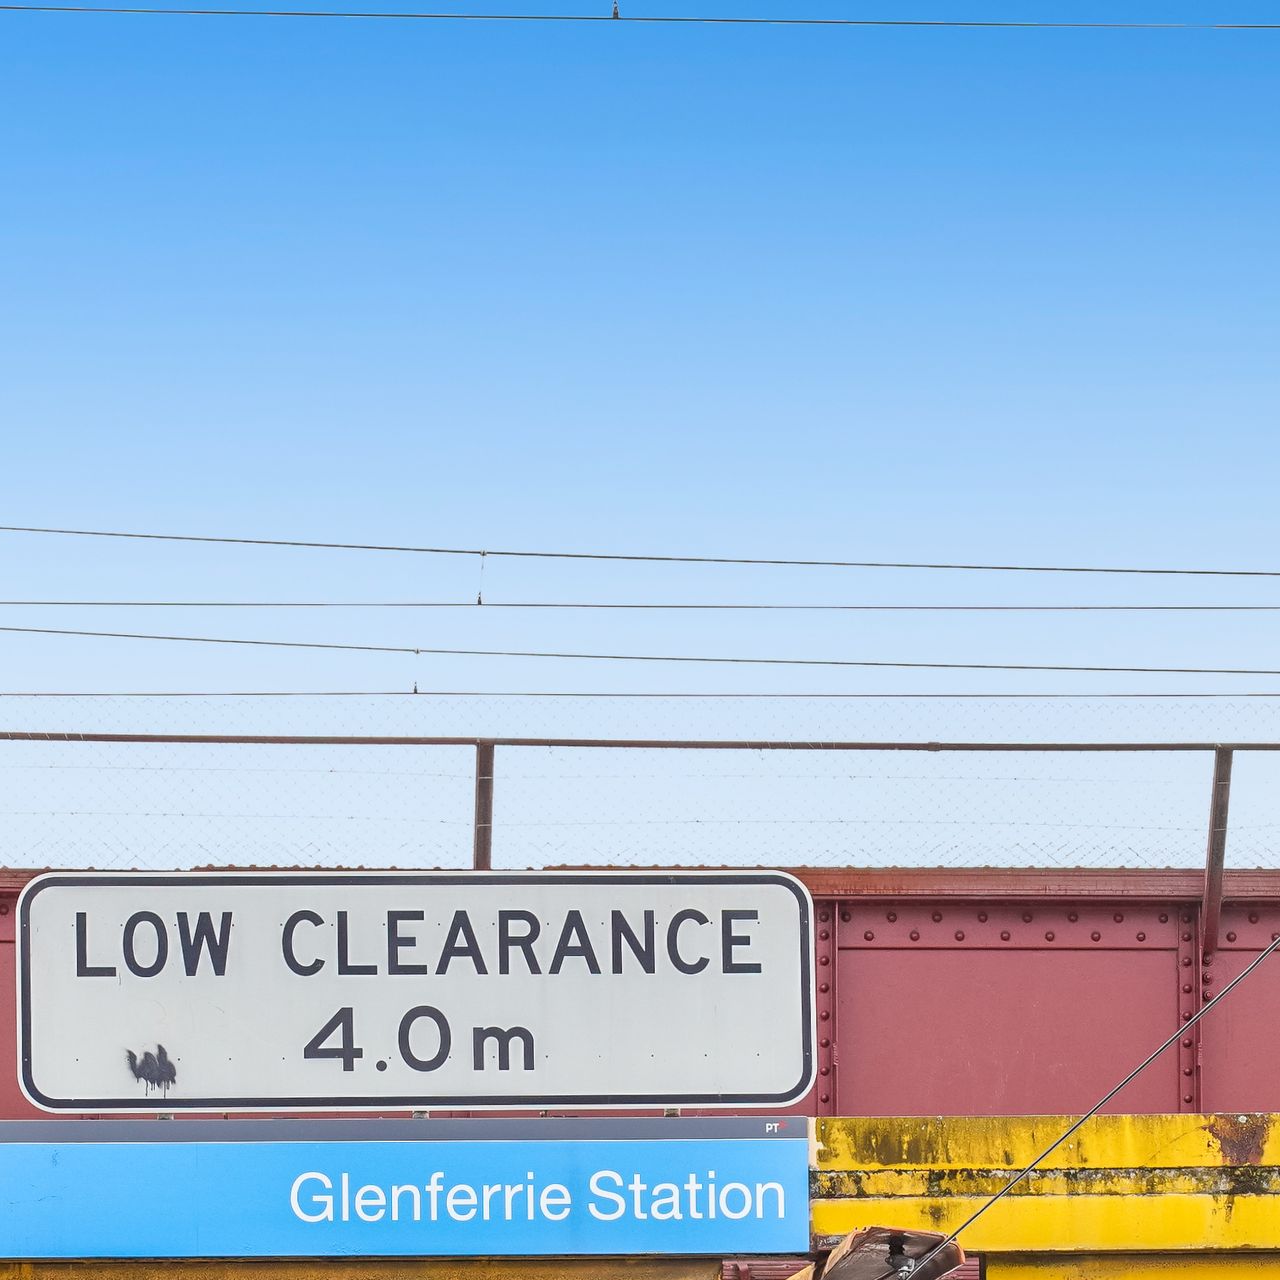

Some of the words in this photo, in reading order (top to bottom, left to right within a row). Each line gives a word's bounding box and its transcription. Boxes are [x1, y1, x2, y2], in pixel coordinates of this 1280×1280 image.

[75, 910, 233, 978] LOW
[282, 908, 763, 976] CLEARANCE
[302, 1005, 452, 1072] 4.0
[473, 1024, 535, 1071] m
[290, 1170, 571, 1223] Glenferrie
[588, 1168, 785, 1221] Station
